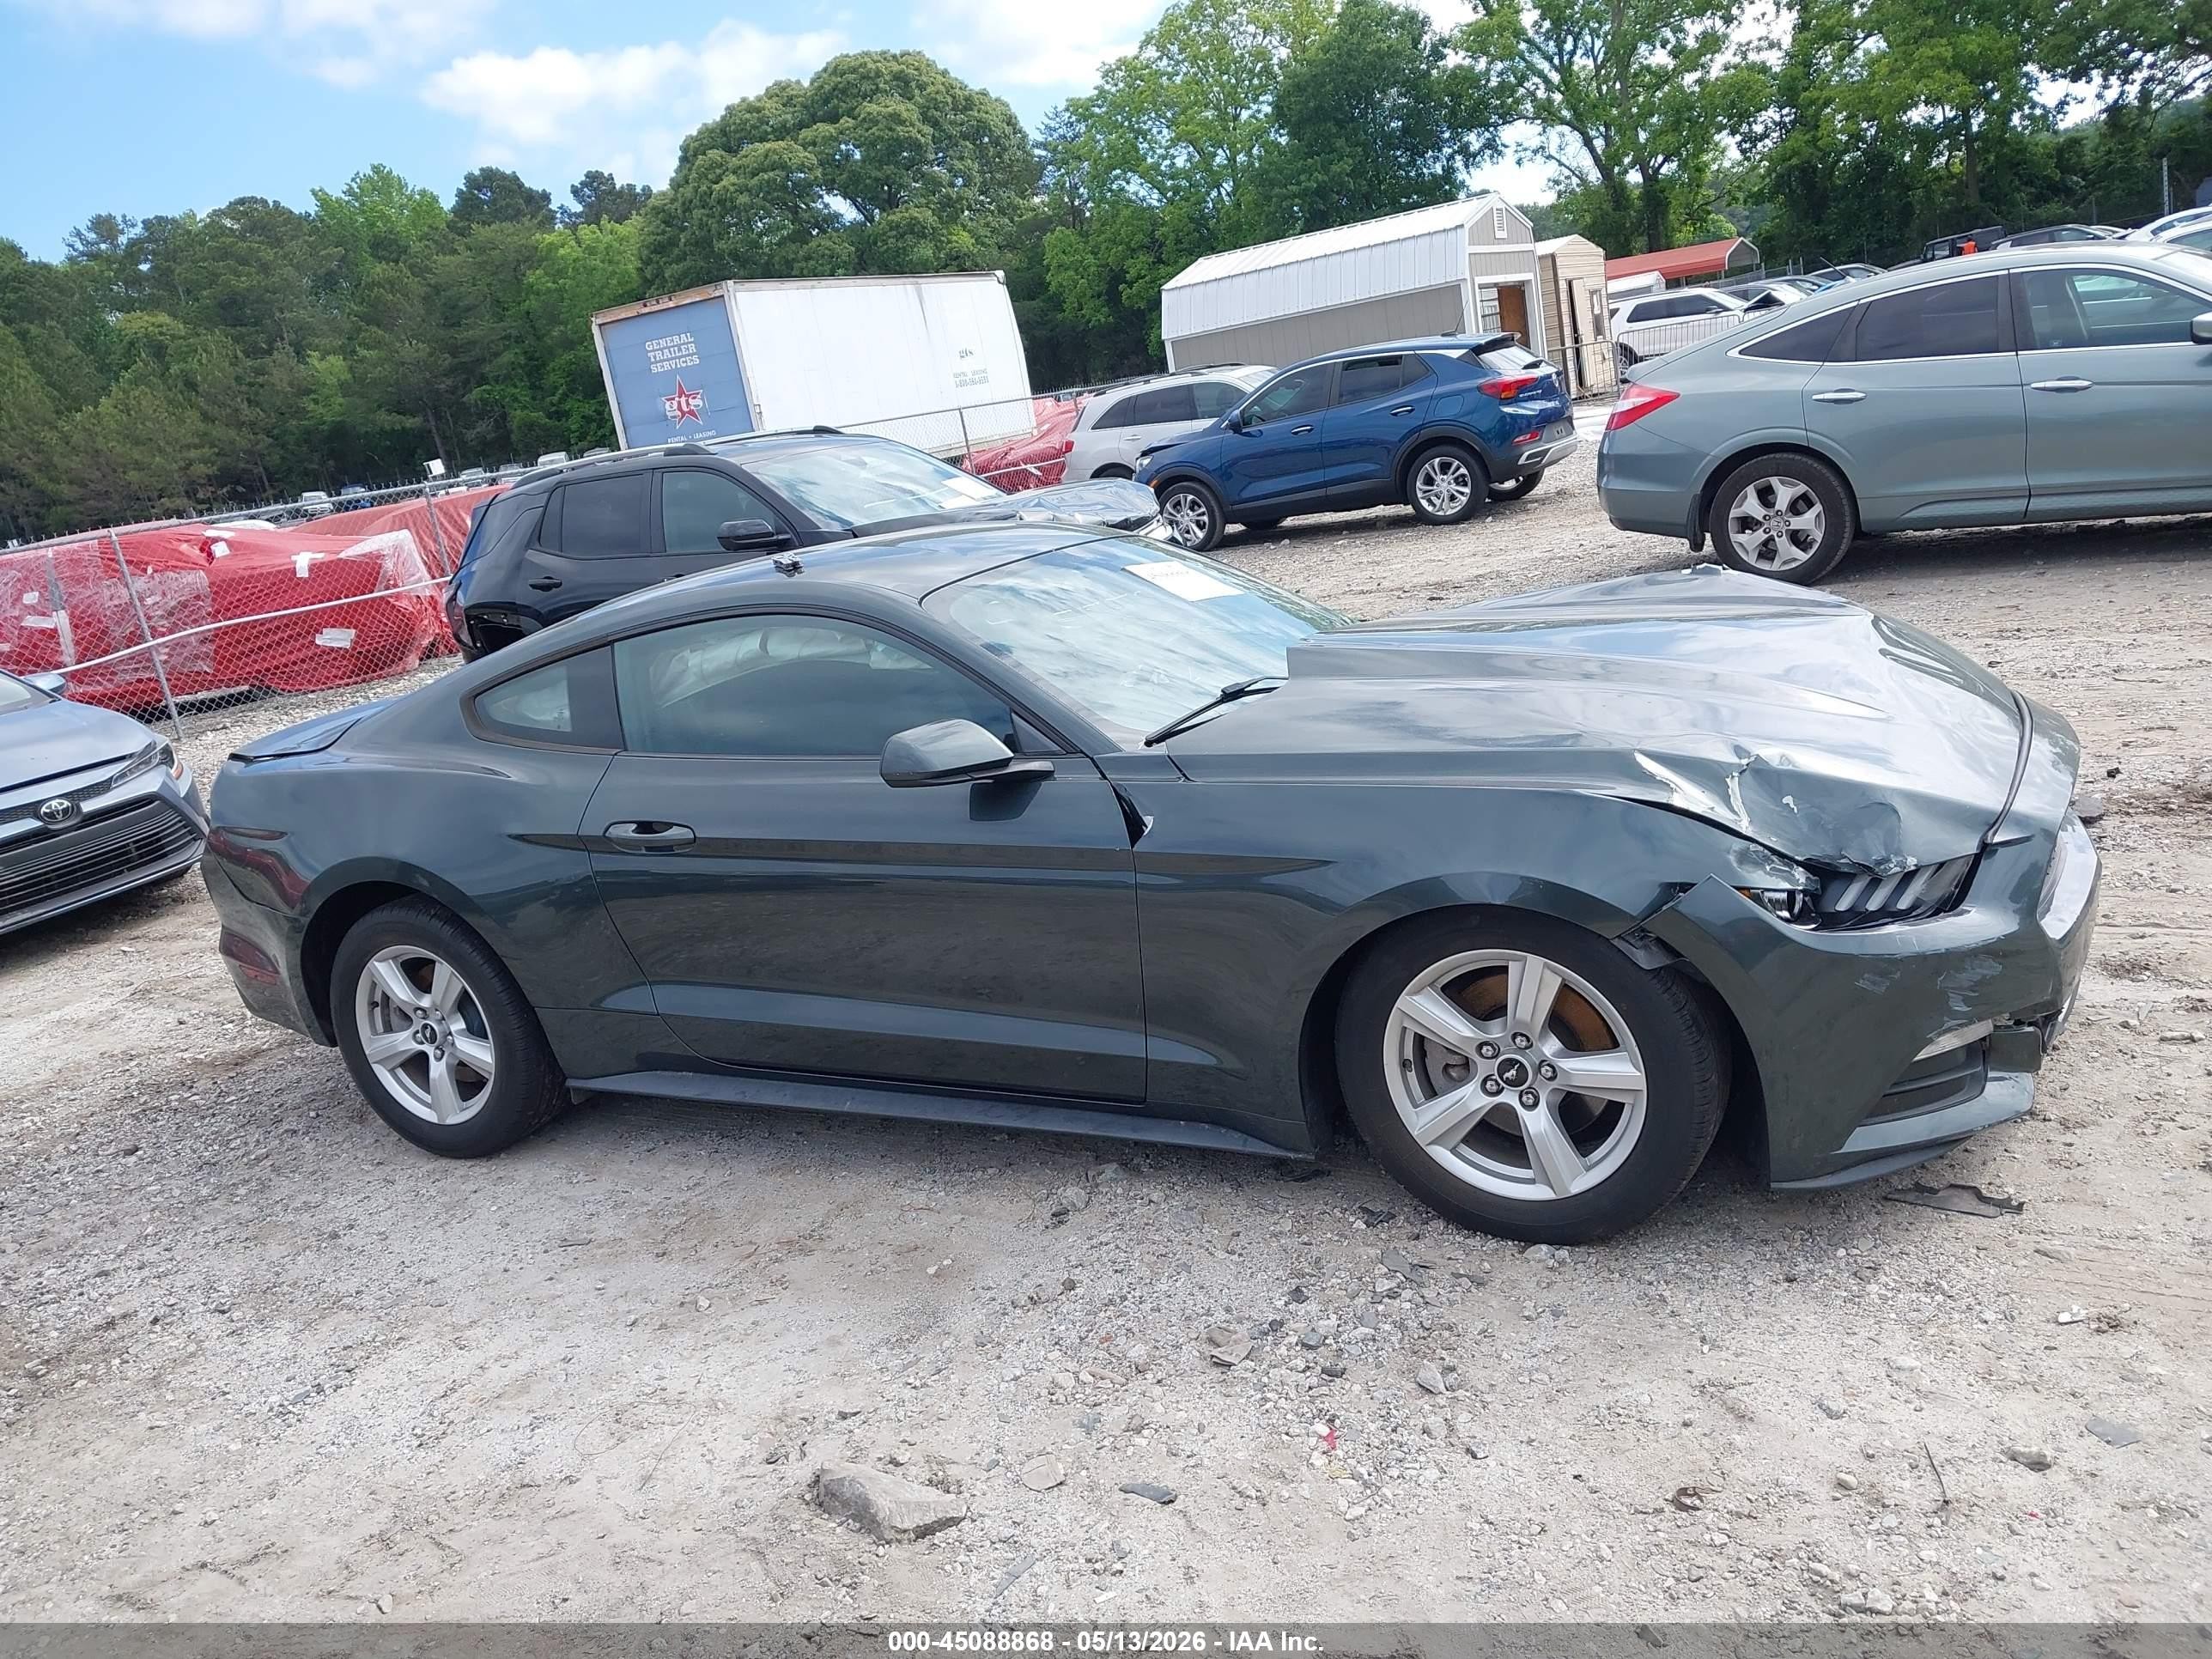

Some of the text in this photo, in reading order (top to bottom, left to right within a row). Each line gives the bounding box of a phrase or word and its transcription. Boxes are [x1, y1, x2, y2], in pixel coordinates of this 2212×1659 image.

[645, 332, 694, 351] GENERAL
[647, 343, 696, 362] TRAILER
[650, 355, 700, 374] SERVICES
[665, 393, 703, 421] gts
[667, 429, 717, 444] RENTAL LEASING
